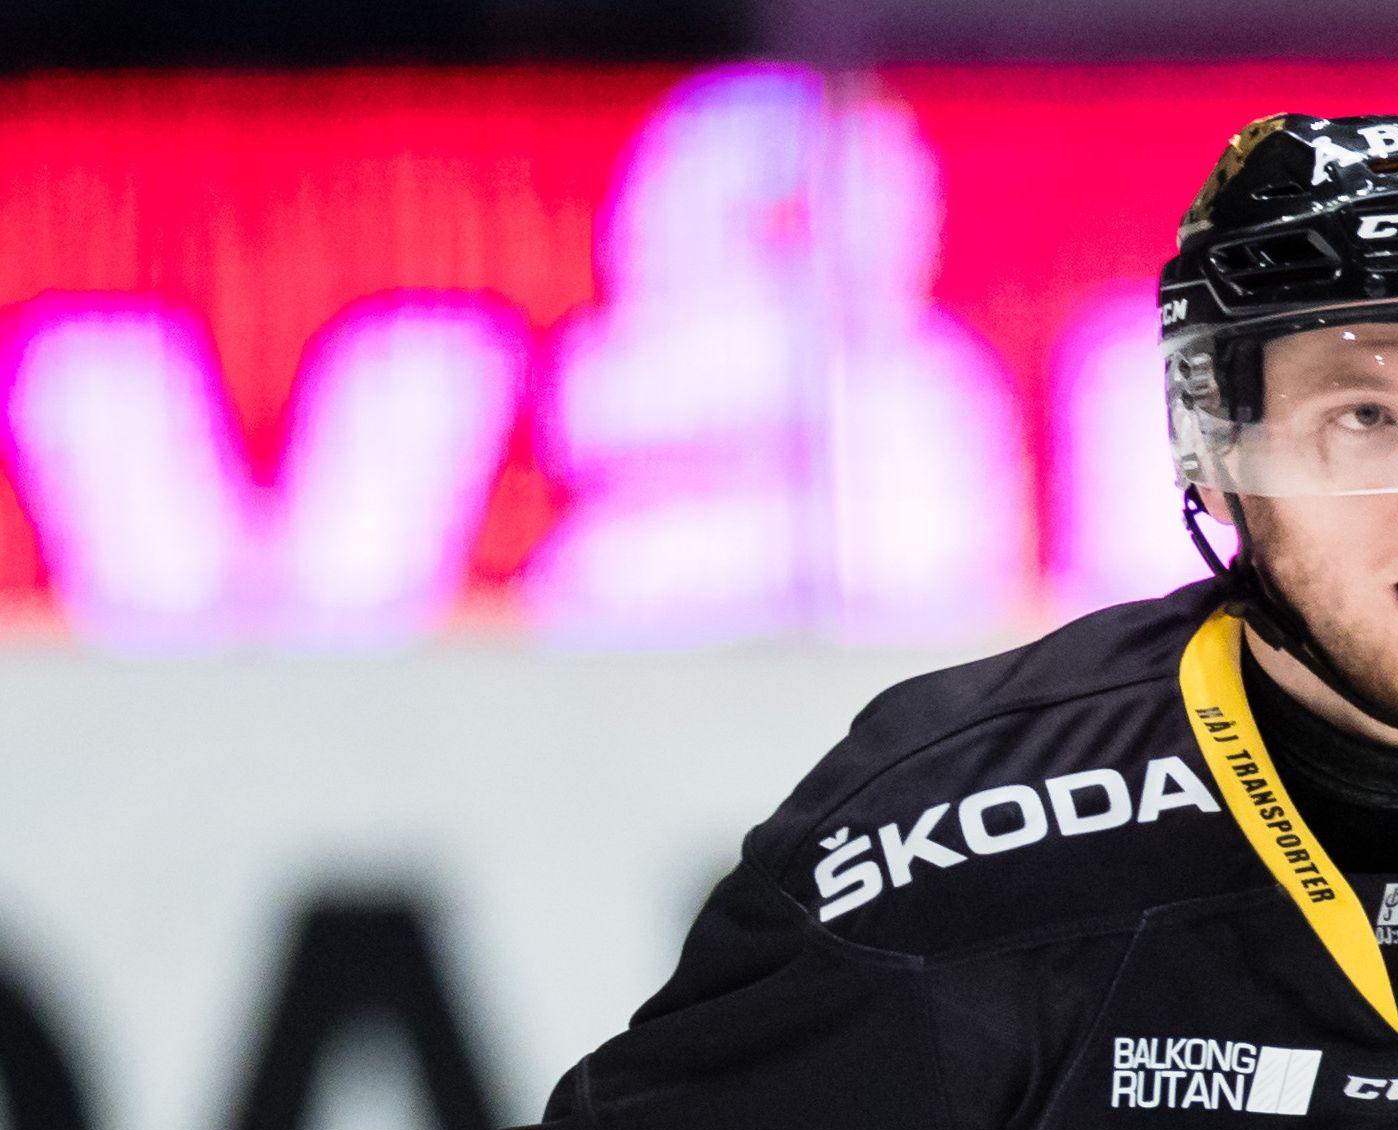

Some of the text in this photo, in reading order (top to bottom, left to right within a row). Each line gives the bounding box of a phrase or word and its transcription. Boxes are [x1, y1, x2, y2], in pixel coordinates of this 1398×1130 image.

[1158, 298, 1188, 326] CM
[813, 756, 1222, 923] ŠKODA
[1226, 749, 1336, 903] TRANSPORTER
[1113, 1037, 1257, 1073] BALKONG
[1111, 1072, 1245, 1111] RUTAN
